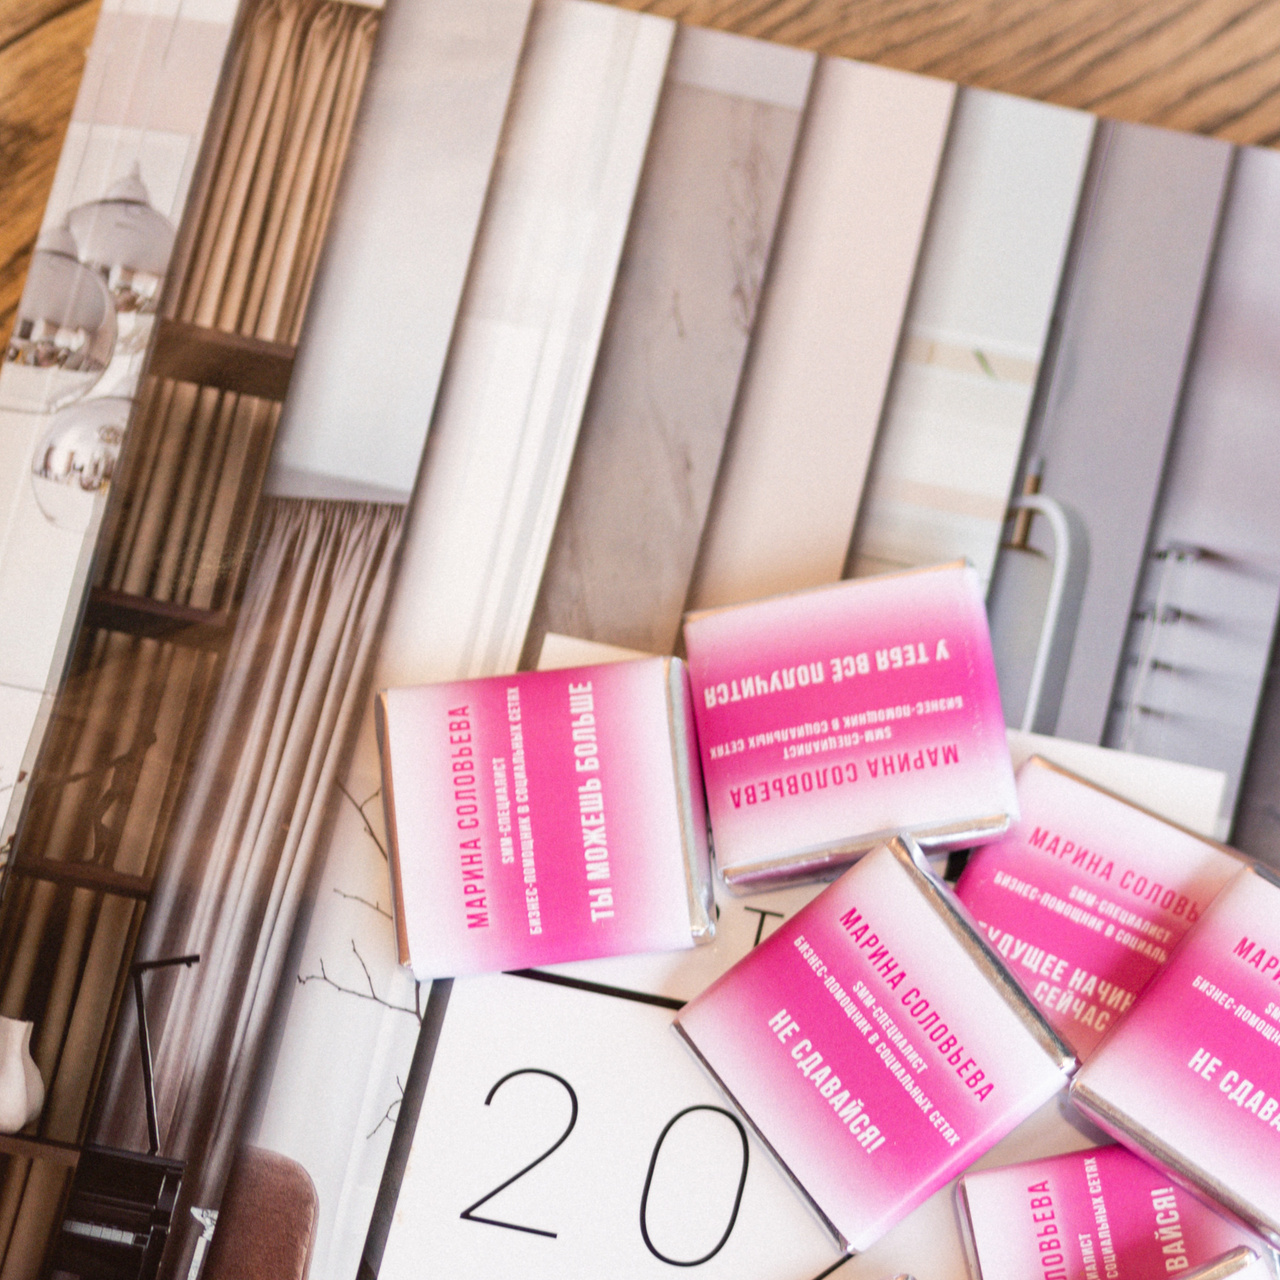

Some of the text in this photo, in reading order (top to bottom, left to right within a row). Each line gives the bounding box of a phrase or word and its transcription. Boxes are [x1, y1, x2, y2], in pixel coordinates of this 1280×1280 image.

[701, 637, 949, 708] У ТЕБЯ ВСЁ ПОЛУЧИТСЯ
[708, 694, 963, 759] БИЗНЕС-ПОМОЩНИК В СОЦИАЛЬНЫХ СЕТЯХ
[781, 724, 892, 759] SMM-СПЕЦИАЛИСТ
[447, 704, 489, 928] МАРИНА СОЛОВЬЕВА
[492, 756, 514, 864] SMM-СПЕЦИАЛИСТ
[506, 686, 542, 935] БИЗНЕС-ПОМОЩНИК В СОЦИАЛЬНЫХ СЕТЯХ
[568, 680, 615, 921] ТЫ МОЖЕШЬ БОЛЬШЕ
[728, 743, 959, 808] МАРИНА СОЛОВЬЕВА
[992, 870, 1170, 965] БИЗНЕС-ПОМОЩНИК В СОЦИАЛЬ
[1027, 825, 1205, 925] МАРИНА СОЛОВЬ
[1067, 884, 1172, 944] SMM-СПЕЦИАЛИСТ
[837, 906, 997, 1103] МАРИНА СОЛОВЬЕВА
[976, 920, 1137, 1015] УДУЩЕЕ НАЧИН
[1029, 978, 1113, 1034] СЕЙЧАС
[791, 934, 961, 1147] БИЗНЕС-ПОМОЩНИК В СОЦИАЛЬНЫХ СЕТЯХ
[850, 980, 928, 1075] SMM-СПЕЦИАЛИСТ
[1186, 1046, 1223, 1082] НЕ
[765, 1007, 801, 1045] НЕ
[788, 1037, 887, 1155] СДАВАЙСЯ!
[1083, 1156, 1102, 1193] СЕТЯХ
[1091, 1194, 1119, 1279] СОЦИАЛЬНЫХ
[1150, 1185, 1188, 1272] ВАЙСЯ!
